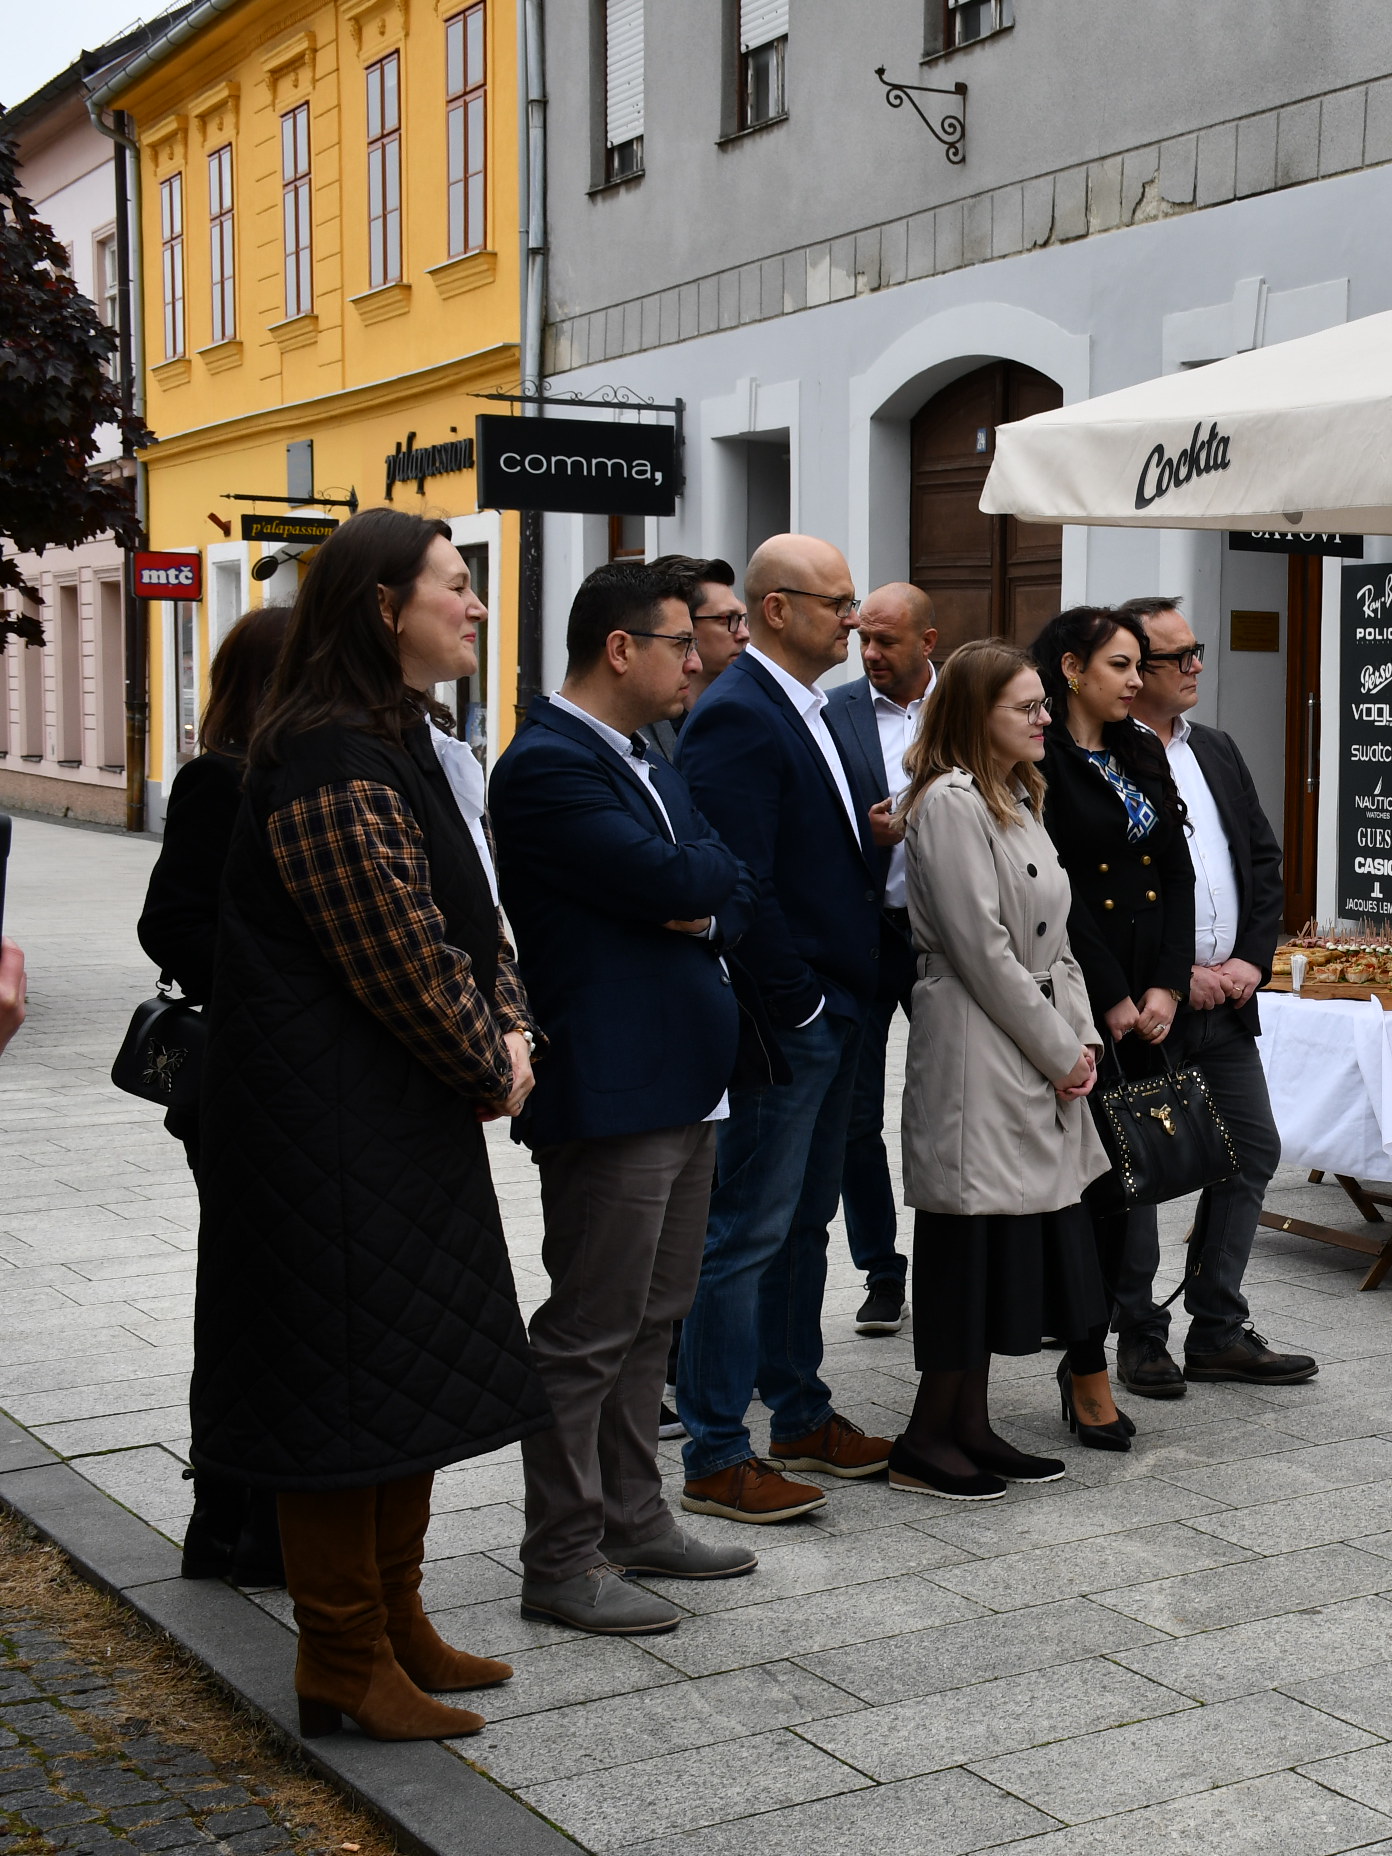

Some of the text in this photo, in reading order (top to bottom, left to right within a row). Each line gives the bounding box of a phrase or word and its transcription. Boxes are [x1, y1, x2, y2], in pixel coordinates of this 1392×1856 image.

[499, 452, 663, 486] comma,
[1135, 421, 1230, 510] Cockta
[140, 565, 193, 585] mtč
[1365, 811, 1390, 819] WATCHES
[1345, 898, 1377, 913] JACQUES
